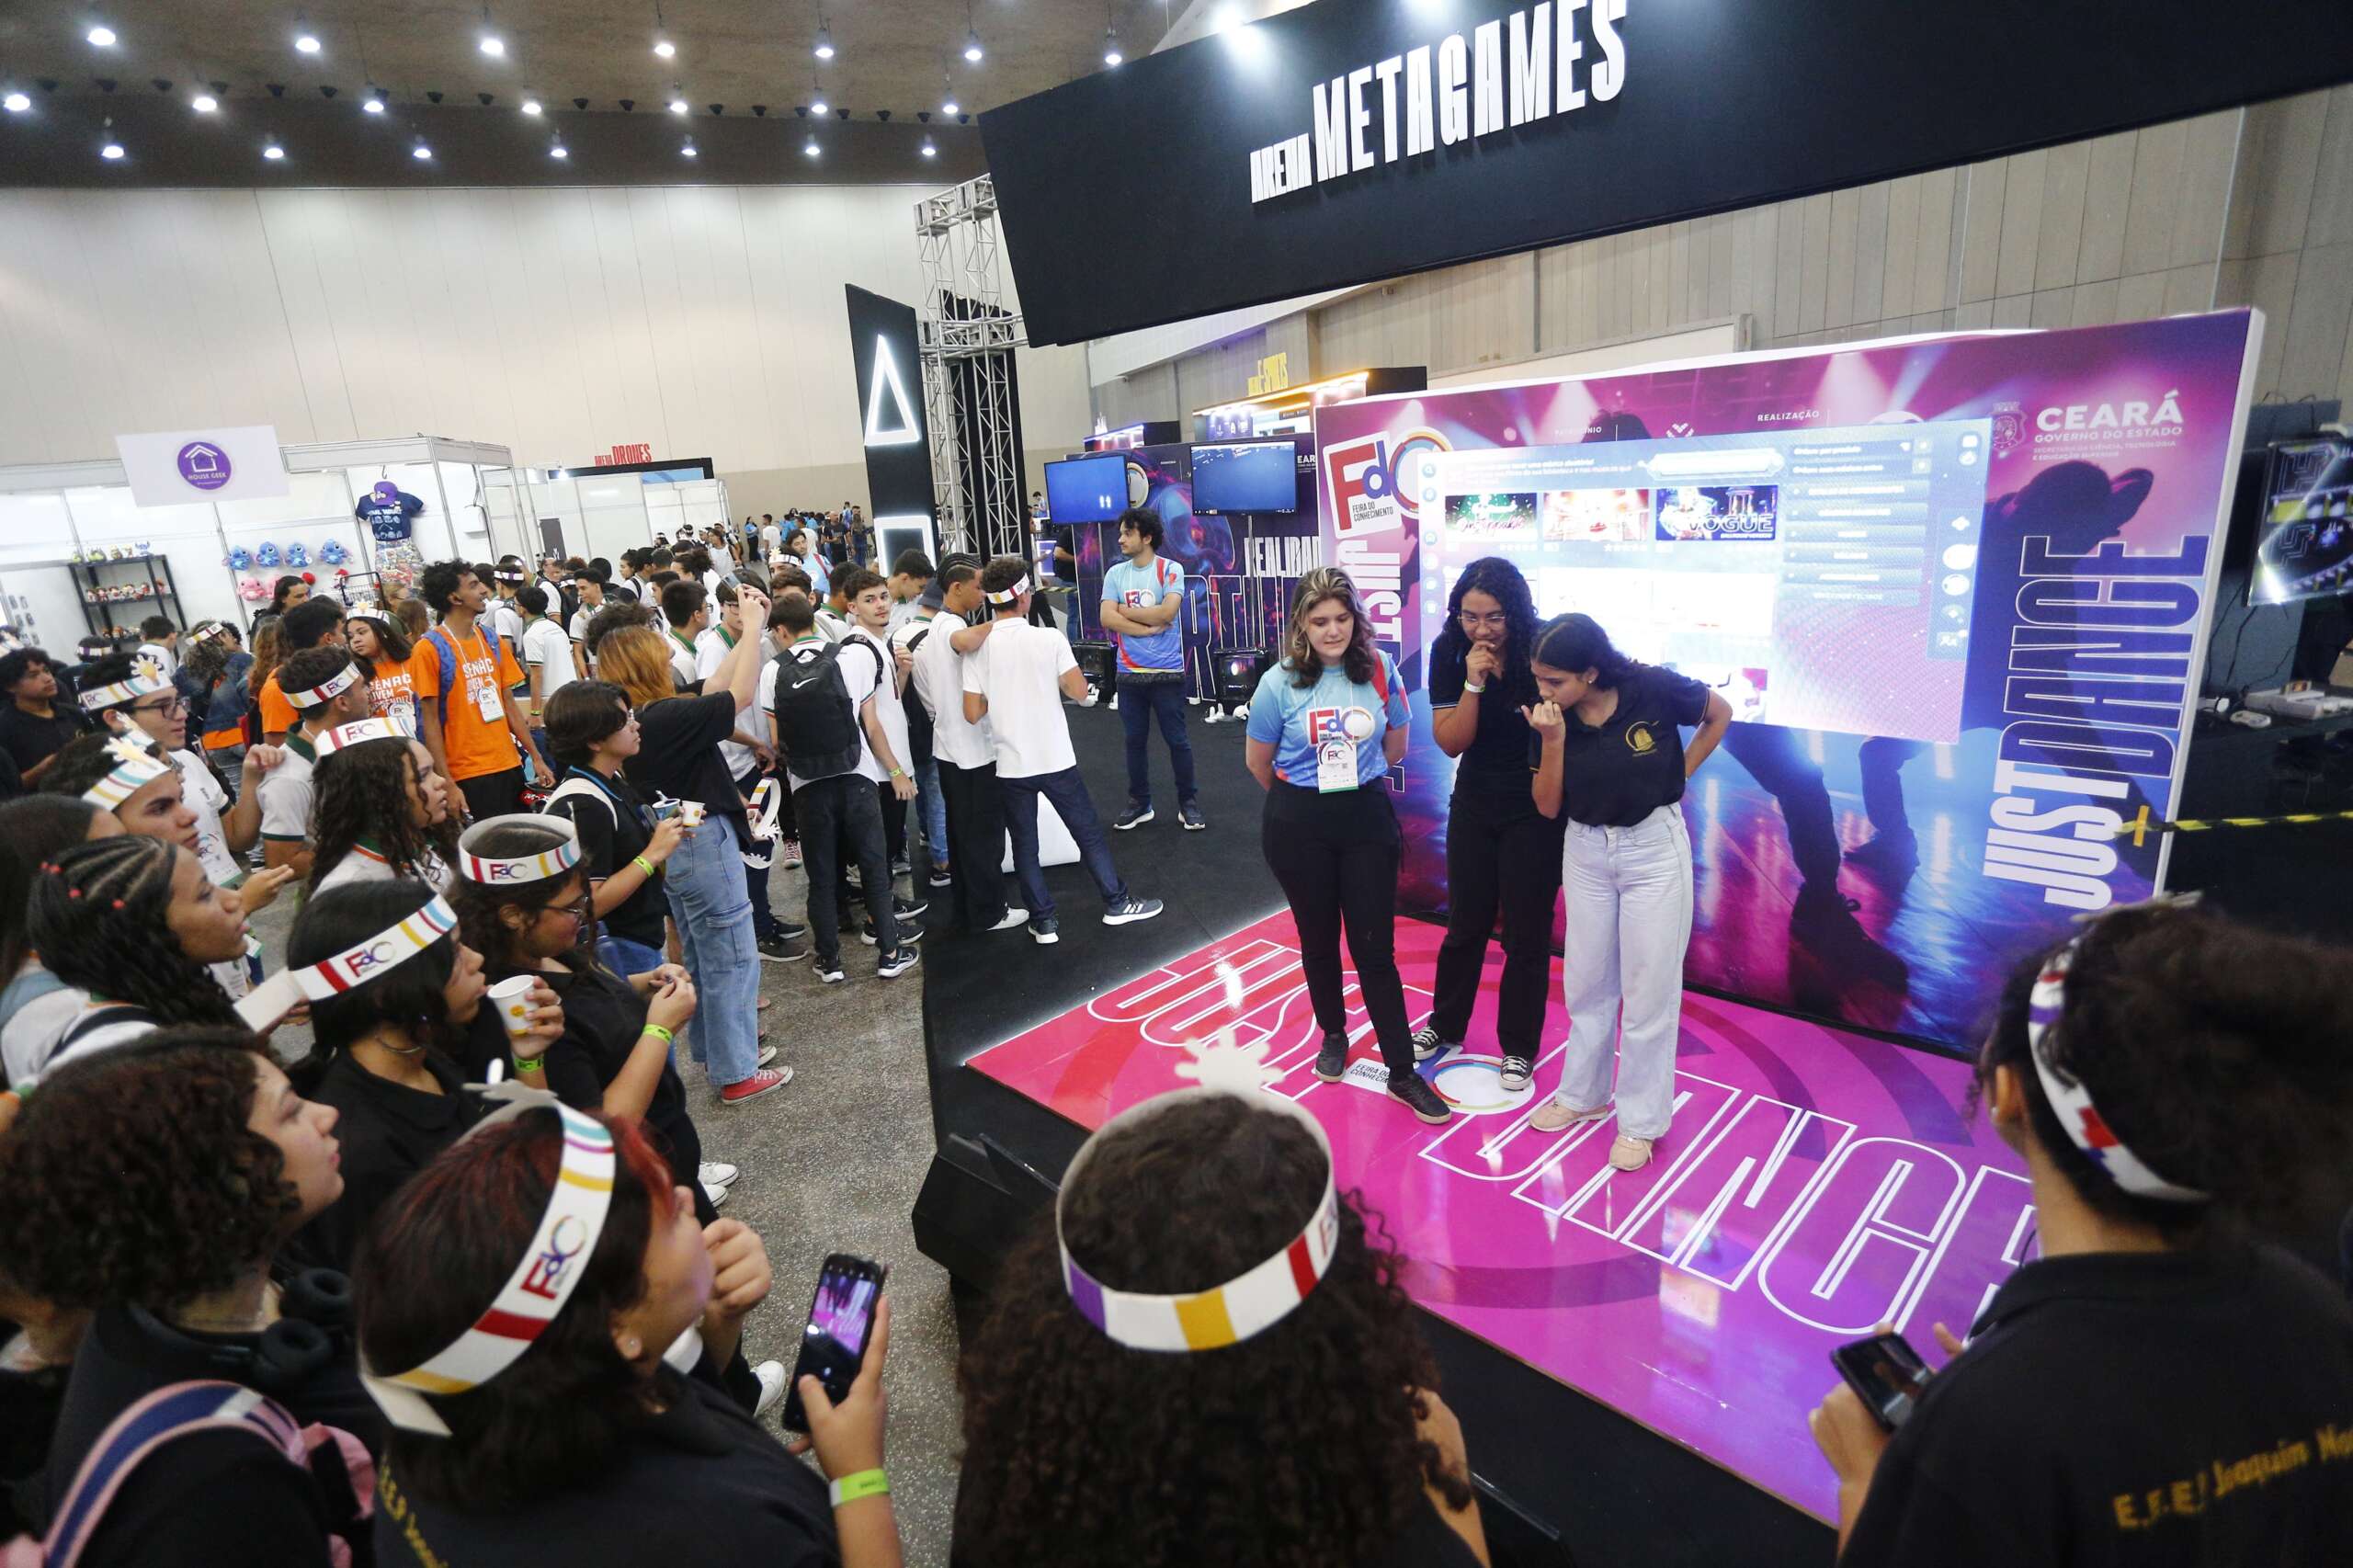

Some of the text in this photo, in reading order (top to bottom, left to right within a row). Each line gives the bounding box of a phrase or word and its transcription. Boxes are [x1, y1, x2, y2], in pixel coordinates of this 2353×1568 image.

[1250, 0, 1628, 203] ARENA METAGAMES
[1757, 410, 1820, 423] REALIZAÇÃO
[2036, 389, 2184, 432] CEARÁ
[2034, 426, 2184, 443] GOVERNO DO ESTADO
[611, 443, 653, 465] DRONES
[1352, 501, 1376, 514] FEIRA DO
[1353, 506, 1394, 522] CONHECIMENTO
[1998, 535, 2211, 779] DANCE
[463, 658, 494, 678] SENAC
[1983, 759, 2131, 912] JUST
[490, 862, 529, 881] FdC
[345, 940, 397, 979] FdC
[1356, 1063, 1379, 1074] FEIRA
[519, 1214, 589, 1301] FdC
